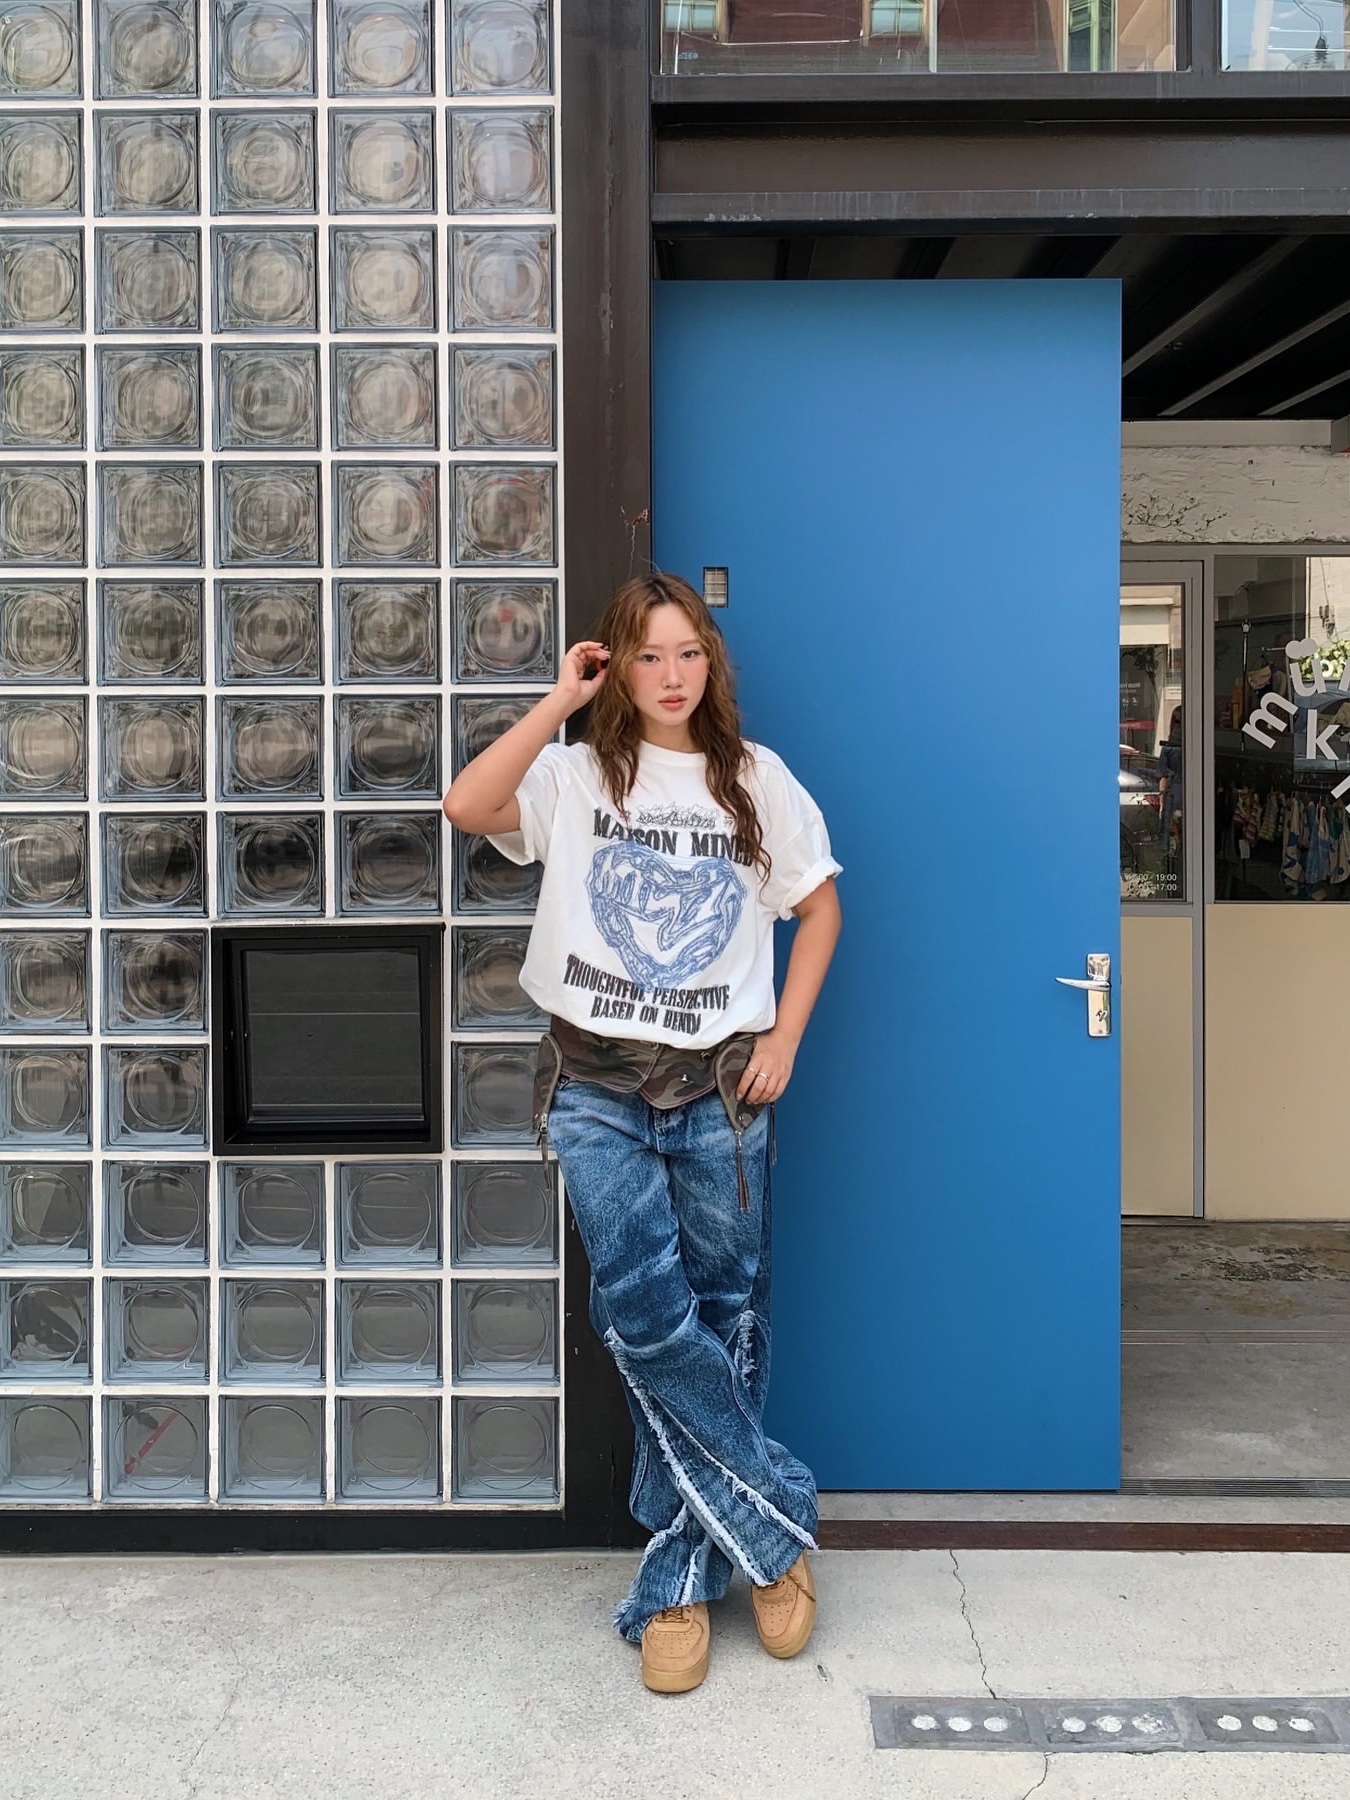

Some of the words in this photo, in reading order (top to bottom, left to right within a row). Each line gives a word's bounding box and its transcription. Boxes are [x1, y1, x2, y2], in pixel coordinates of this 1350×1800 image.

[1241, 638, 1350, 750] mü
[1156, 873, 1177, 881] 19:00
[1156, 883, 1177, 891] 17:00
[563, 953, 645, 1003] THOUGHTFUL
[651, 984, 730, 1011] PERSPECTIVE
[590, 996, 635, 1021] BASED
[639, 1004, 659, 1024] ON
[663, 1009, 702, 1036] DENIM
